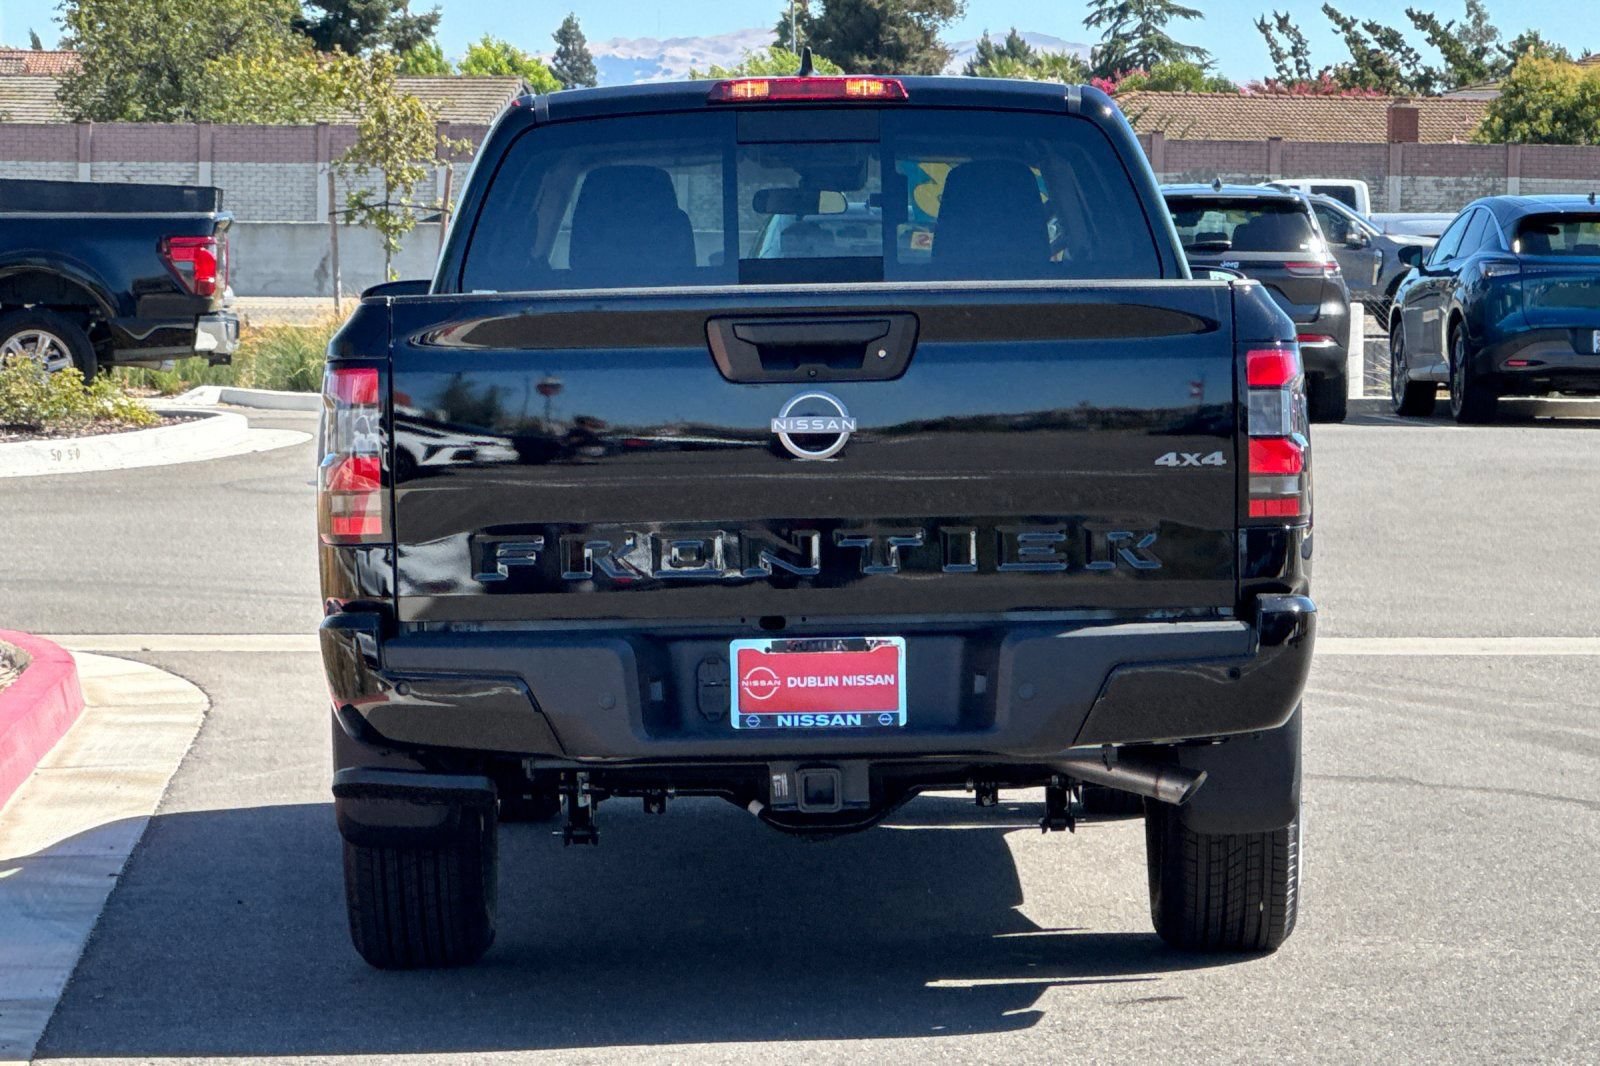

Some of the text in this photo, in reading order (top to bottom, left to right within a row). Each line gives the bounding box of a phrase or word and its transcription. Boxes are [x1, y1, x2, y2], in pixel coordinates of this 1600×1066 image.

[773, 419, 855, 430] NISSAN
[471, 527, 1163, 580] FRONTIER
[741, 679, 781, 687] NISSAN
[787, 674, 895, 688] DUBLIN NISSAN
[777, 714, 862, 727] NISSAN
